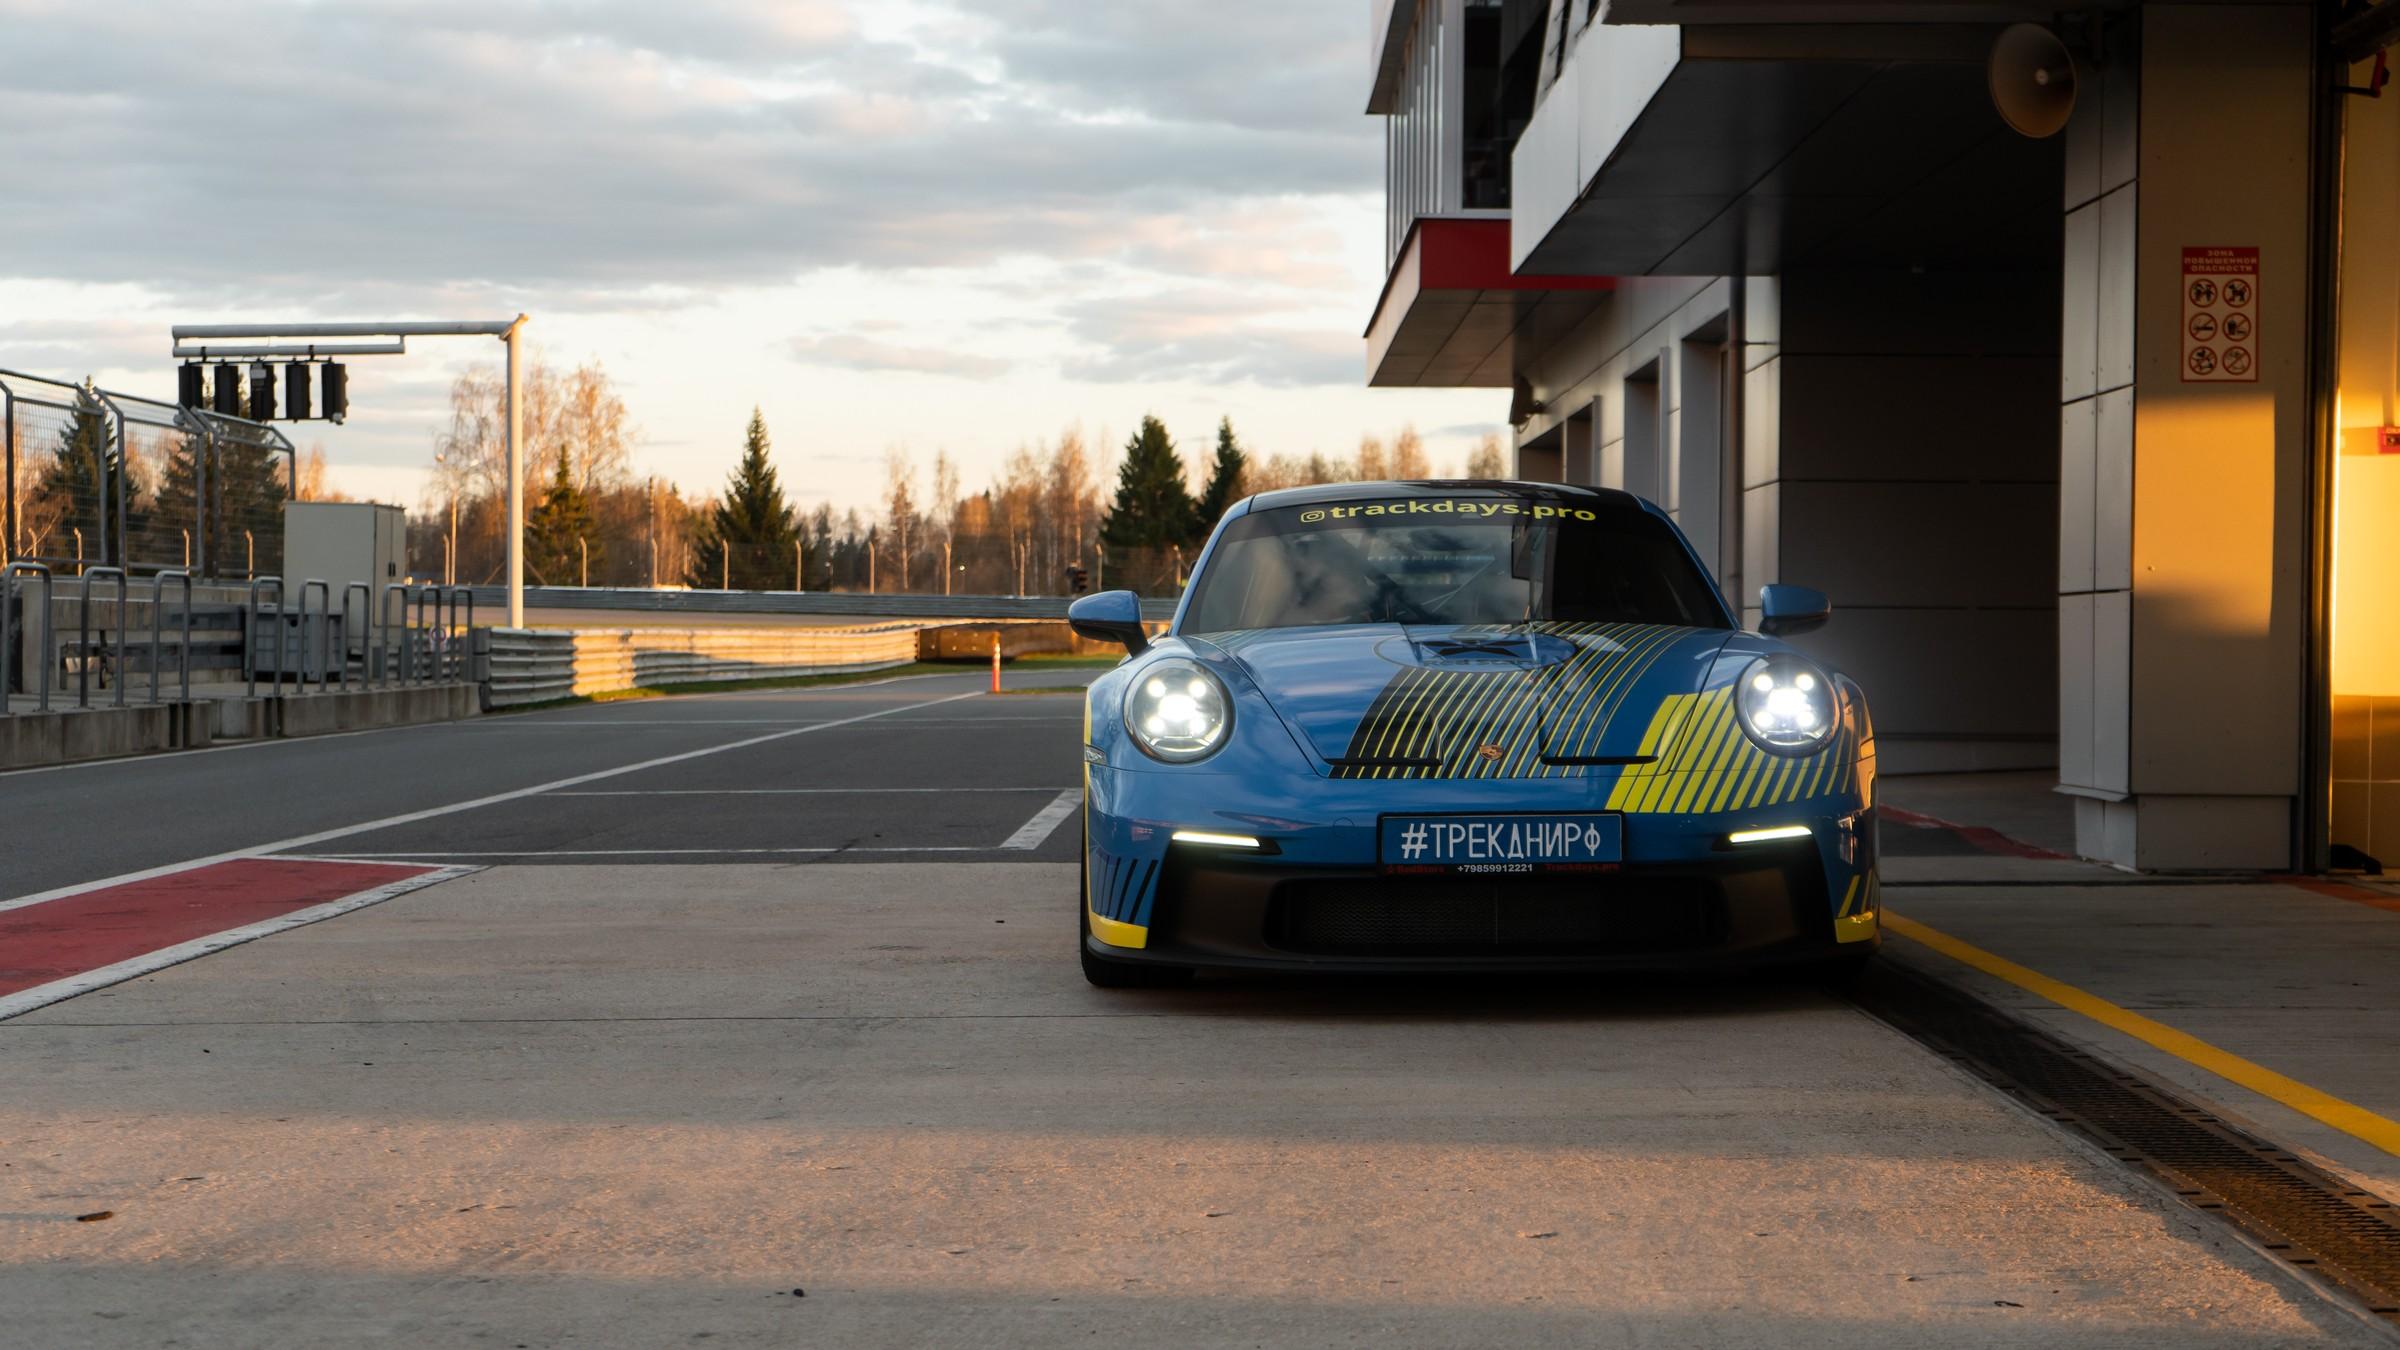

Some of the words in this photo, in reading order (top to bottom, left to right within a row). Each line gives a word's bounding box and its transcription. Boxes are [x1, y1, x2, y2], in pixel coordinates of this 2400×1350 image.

[2207, 249, 2234, 257] ЗОНА
[1329, 500, 1597, 521] trackdays.pro
[1400, 822, 1602, 860] #ТРЕКДНИРФ
[1457, 863, 1534, 873] +79859912221
